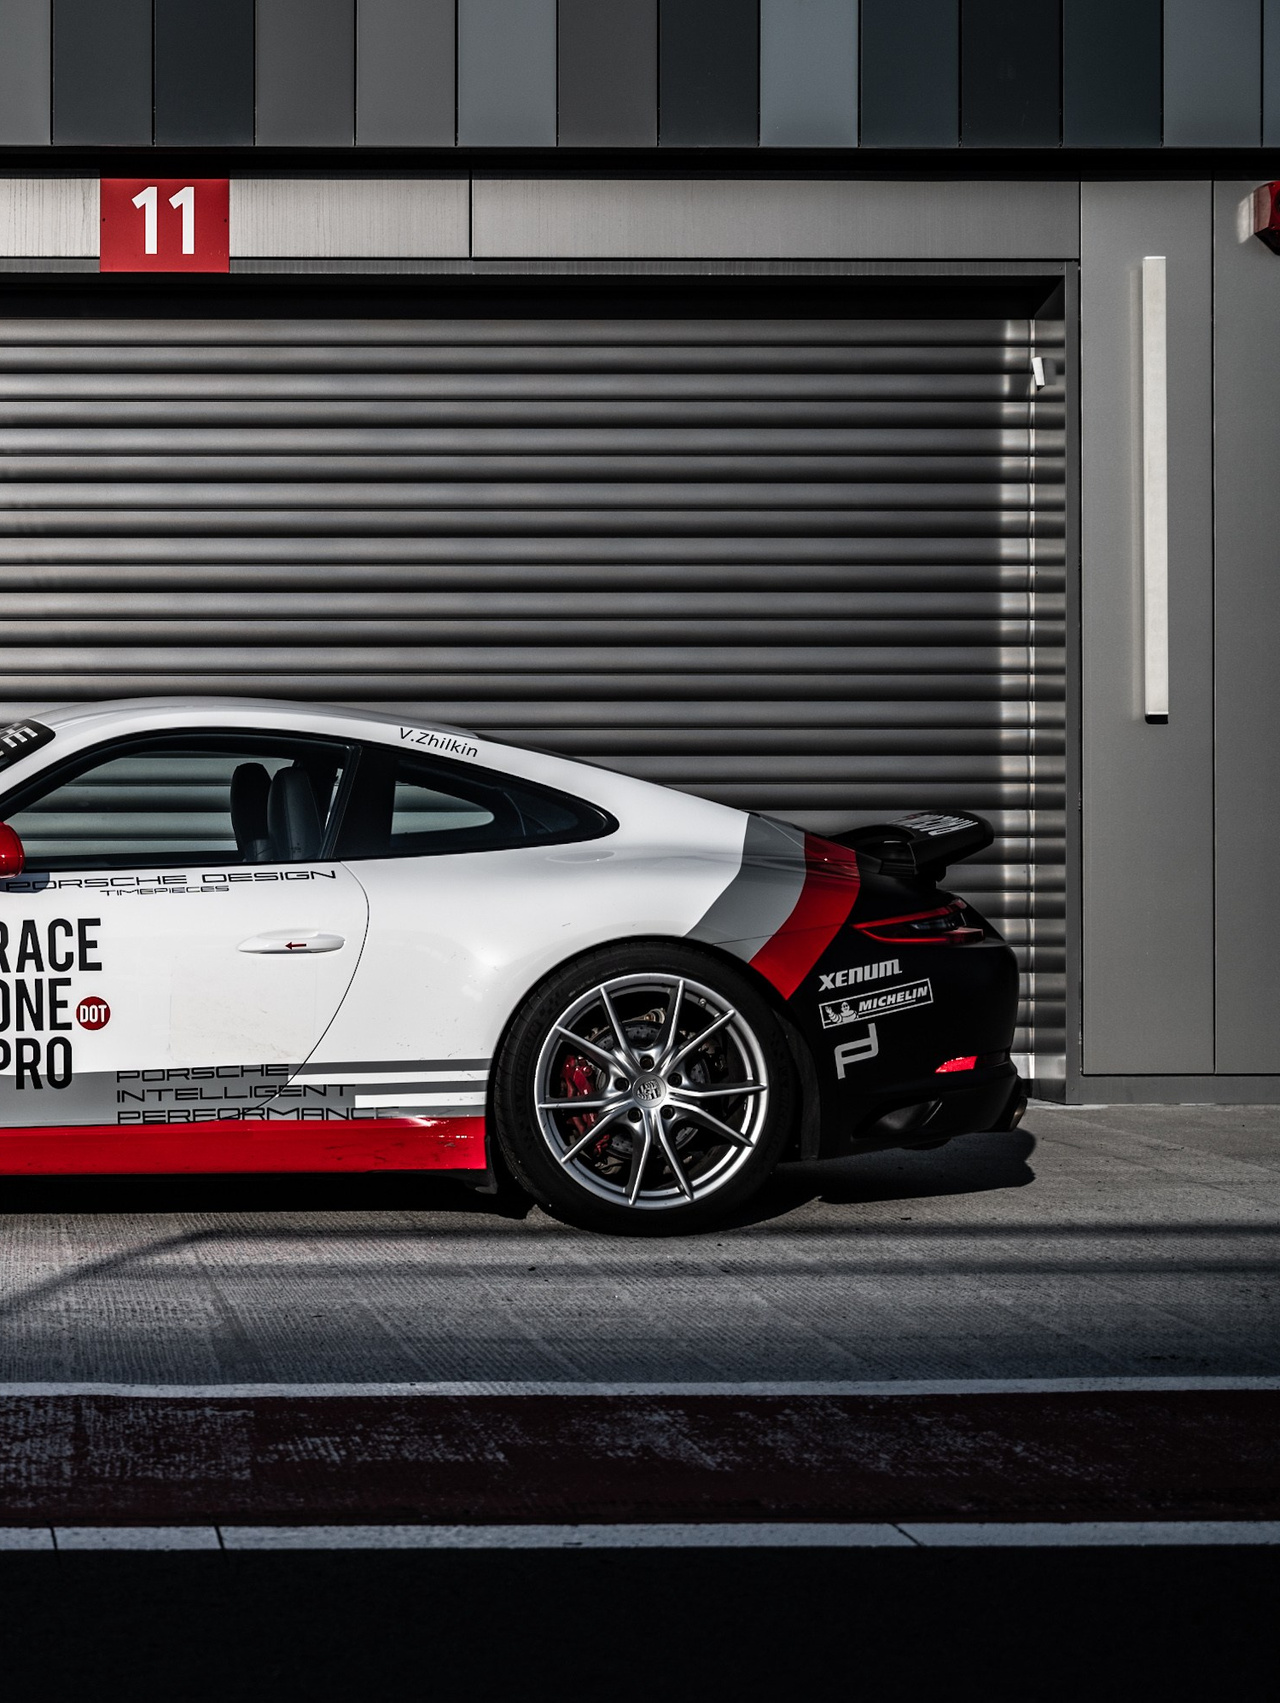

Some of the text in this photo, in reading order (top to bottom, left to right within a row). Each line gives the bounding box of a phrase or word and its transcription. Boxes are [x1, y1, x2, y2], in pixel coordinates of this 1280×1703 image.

[131, 186, 195, 255] 11
[400, 727, 478, 757] V.Zhilkin
[6, 870, 337, 892] PORSCHE DESIGN
[100, 885, 230, 897] TIMEPIECES
[858, 985, 929, 1012] MICHELIN
[79, 1004, 108, 1023] DOT
[117, 1063, 289, 1083] PORSCHE
[117, 1084, 356, 1103] INTELLIGENT
